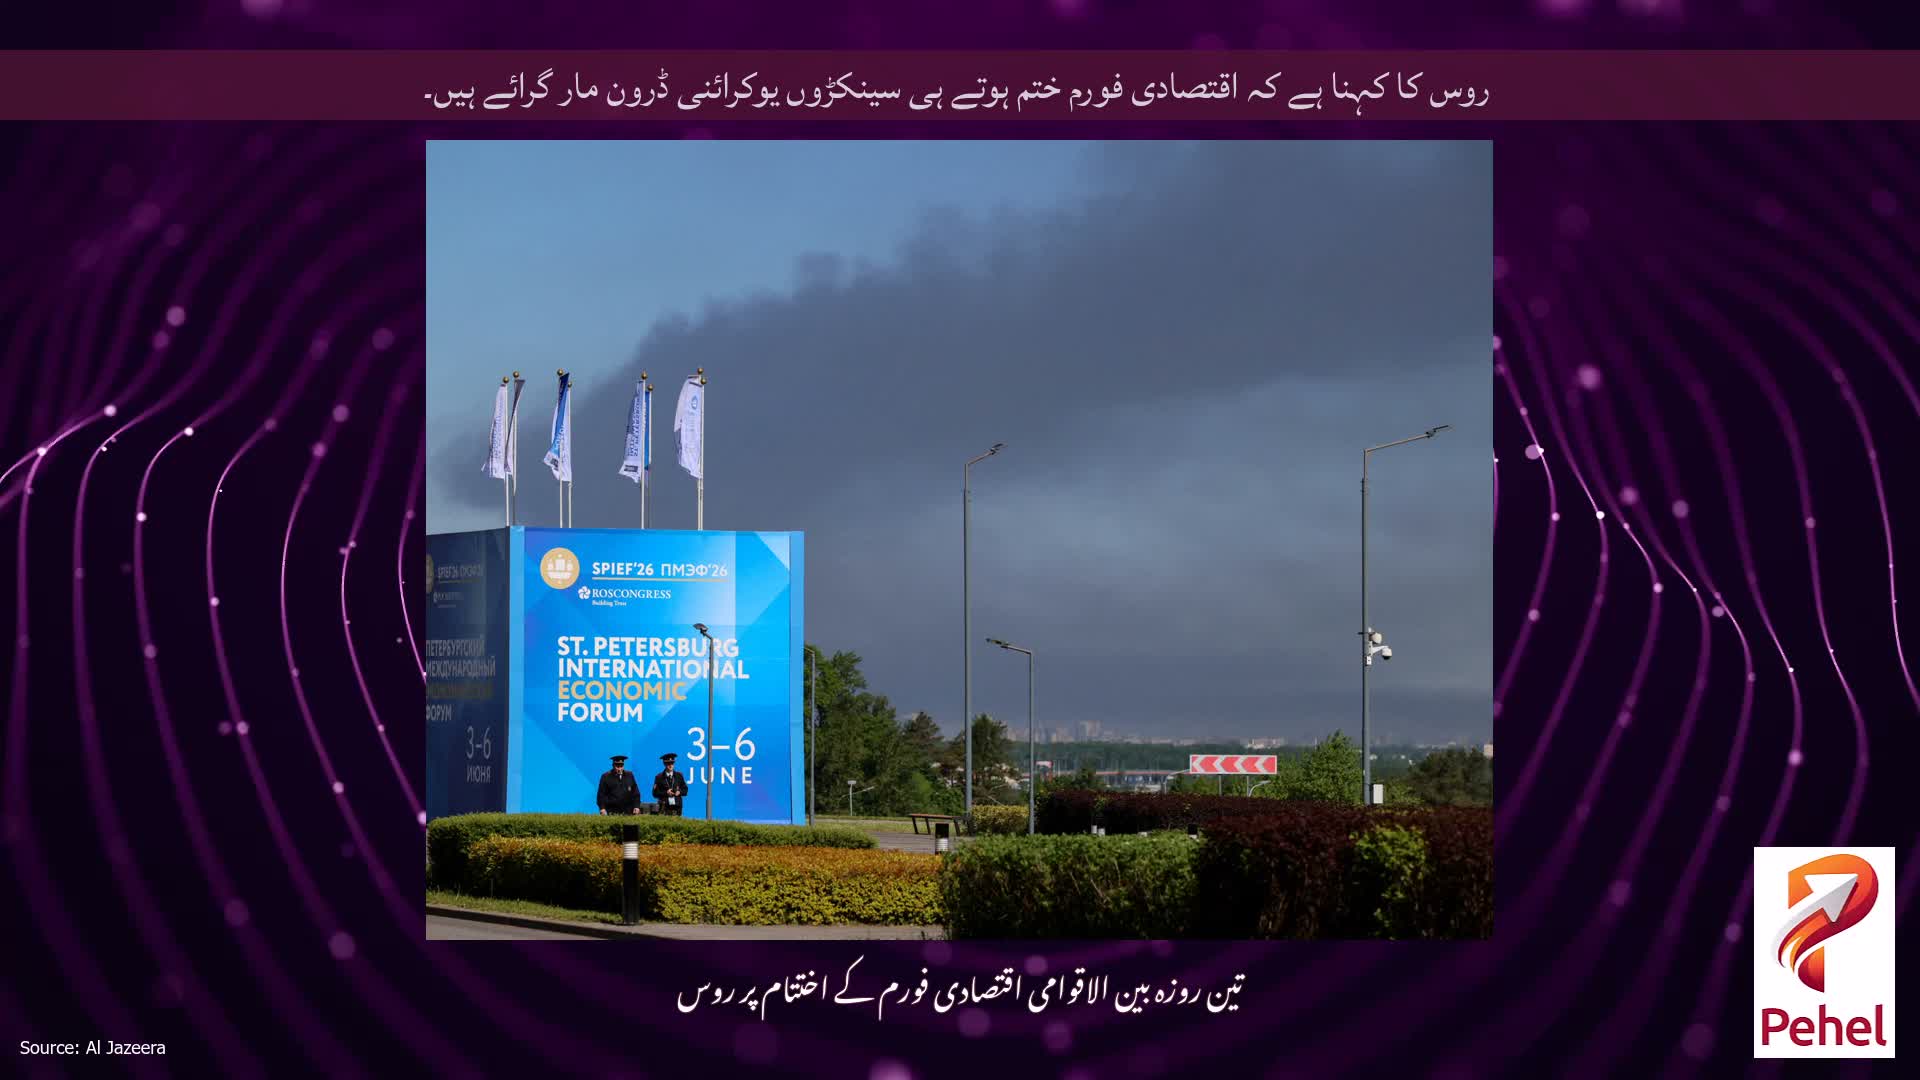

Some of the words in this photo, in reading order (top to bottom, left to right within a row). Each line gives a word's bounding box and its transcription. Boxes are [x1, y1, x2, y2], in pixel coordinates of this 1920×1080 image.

[592, 562, 654, 576] SPIEF'26
[661, 563, 728, 577] ПМЭФ'26
[592, 588, 672, 599] ROSCONGRESS
[557, 636, 588, 656] ST.
[594, 637, 739, 657] PETERSBURG
[558, 658, 750, 679] INTERNATIONAL
[558, 681, 687, 700] ECONOMIC
[558, 702, 643, 722] FORUM
[466, 765, 491, 783] ИЮНЯ
[687, 767, 753, 784] JUNE
